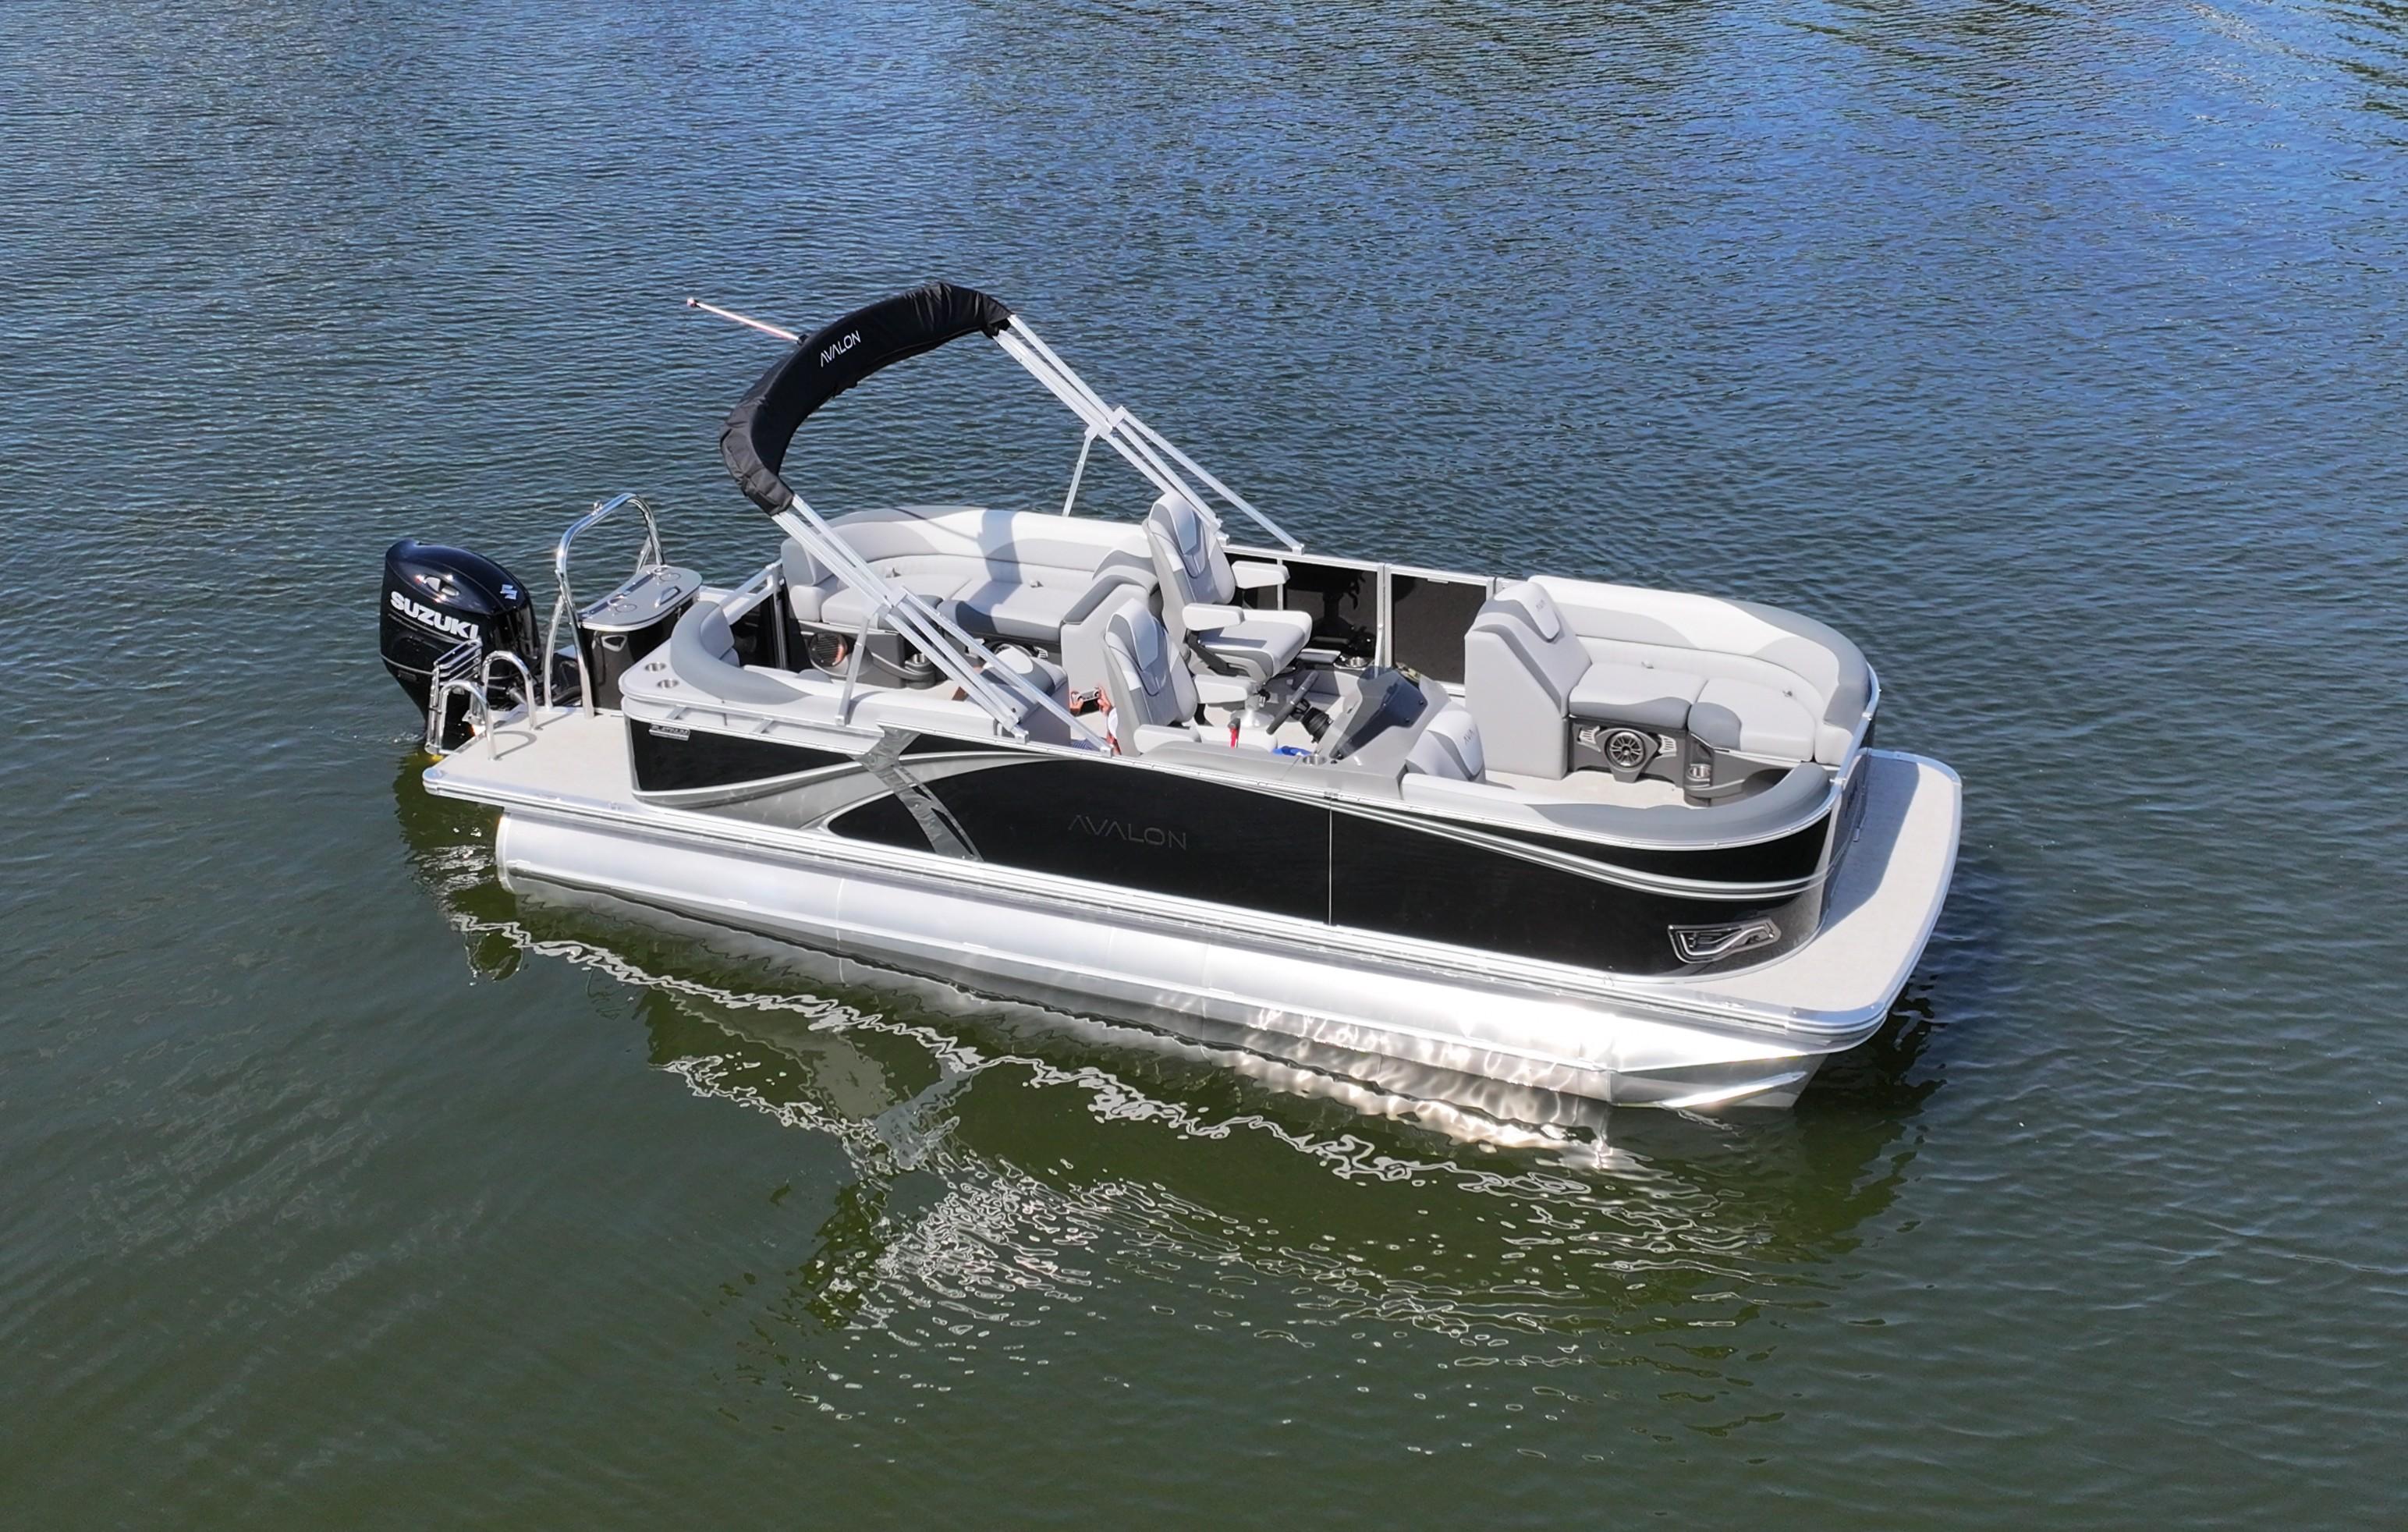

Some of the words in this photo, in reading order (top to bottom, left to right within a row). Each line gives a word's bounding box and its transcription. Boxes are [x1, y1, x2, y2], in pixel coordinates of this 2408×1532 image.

[821, 330, 861, 368] AVALON
[390, 590, 480, 640] SUZUKI
[1068, 814, 1186, 851] AVALON
